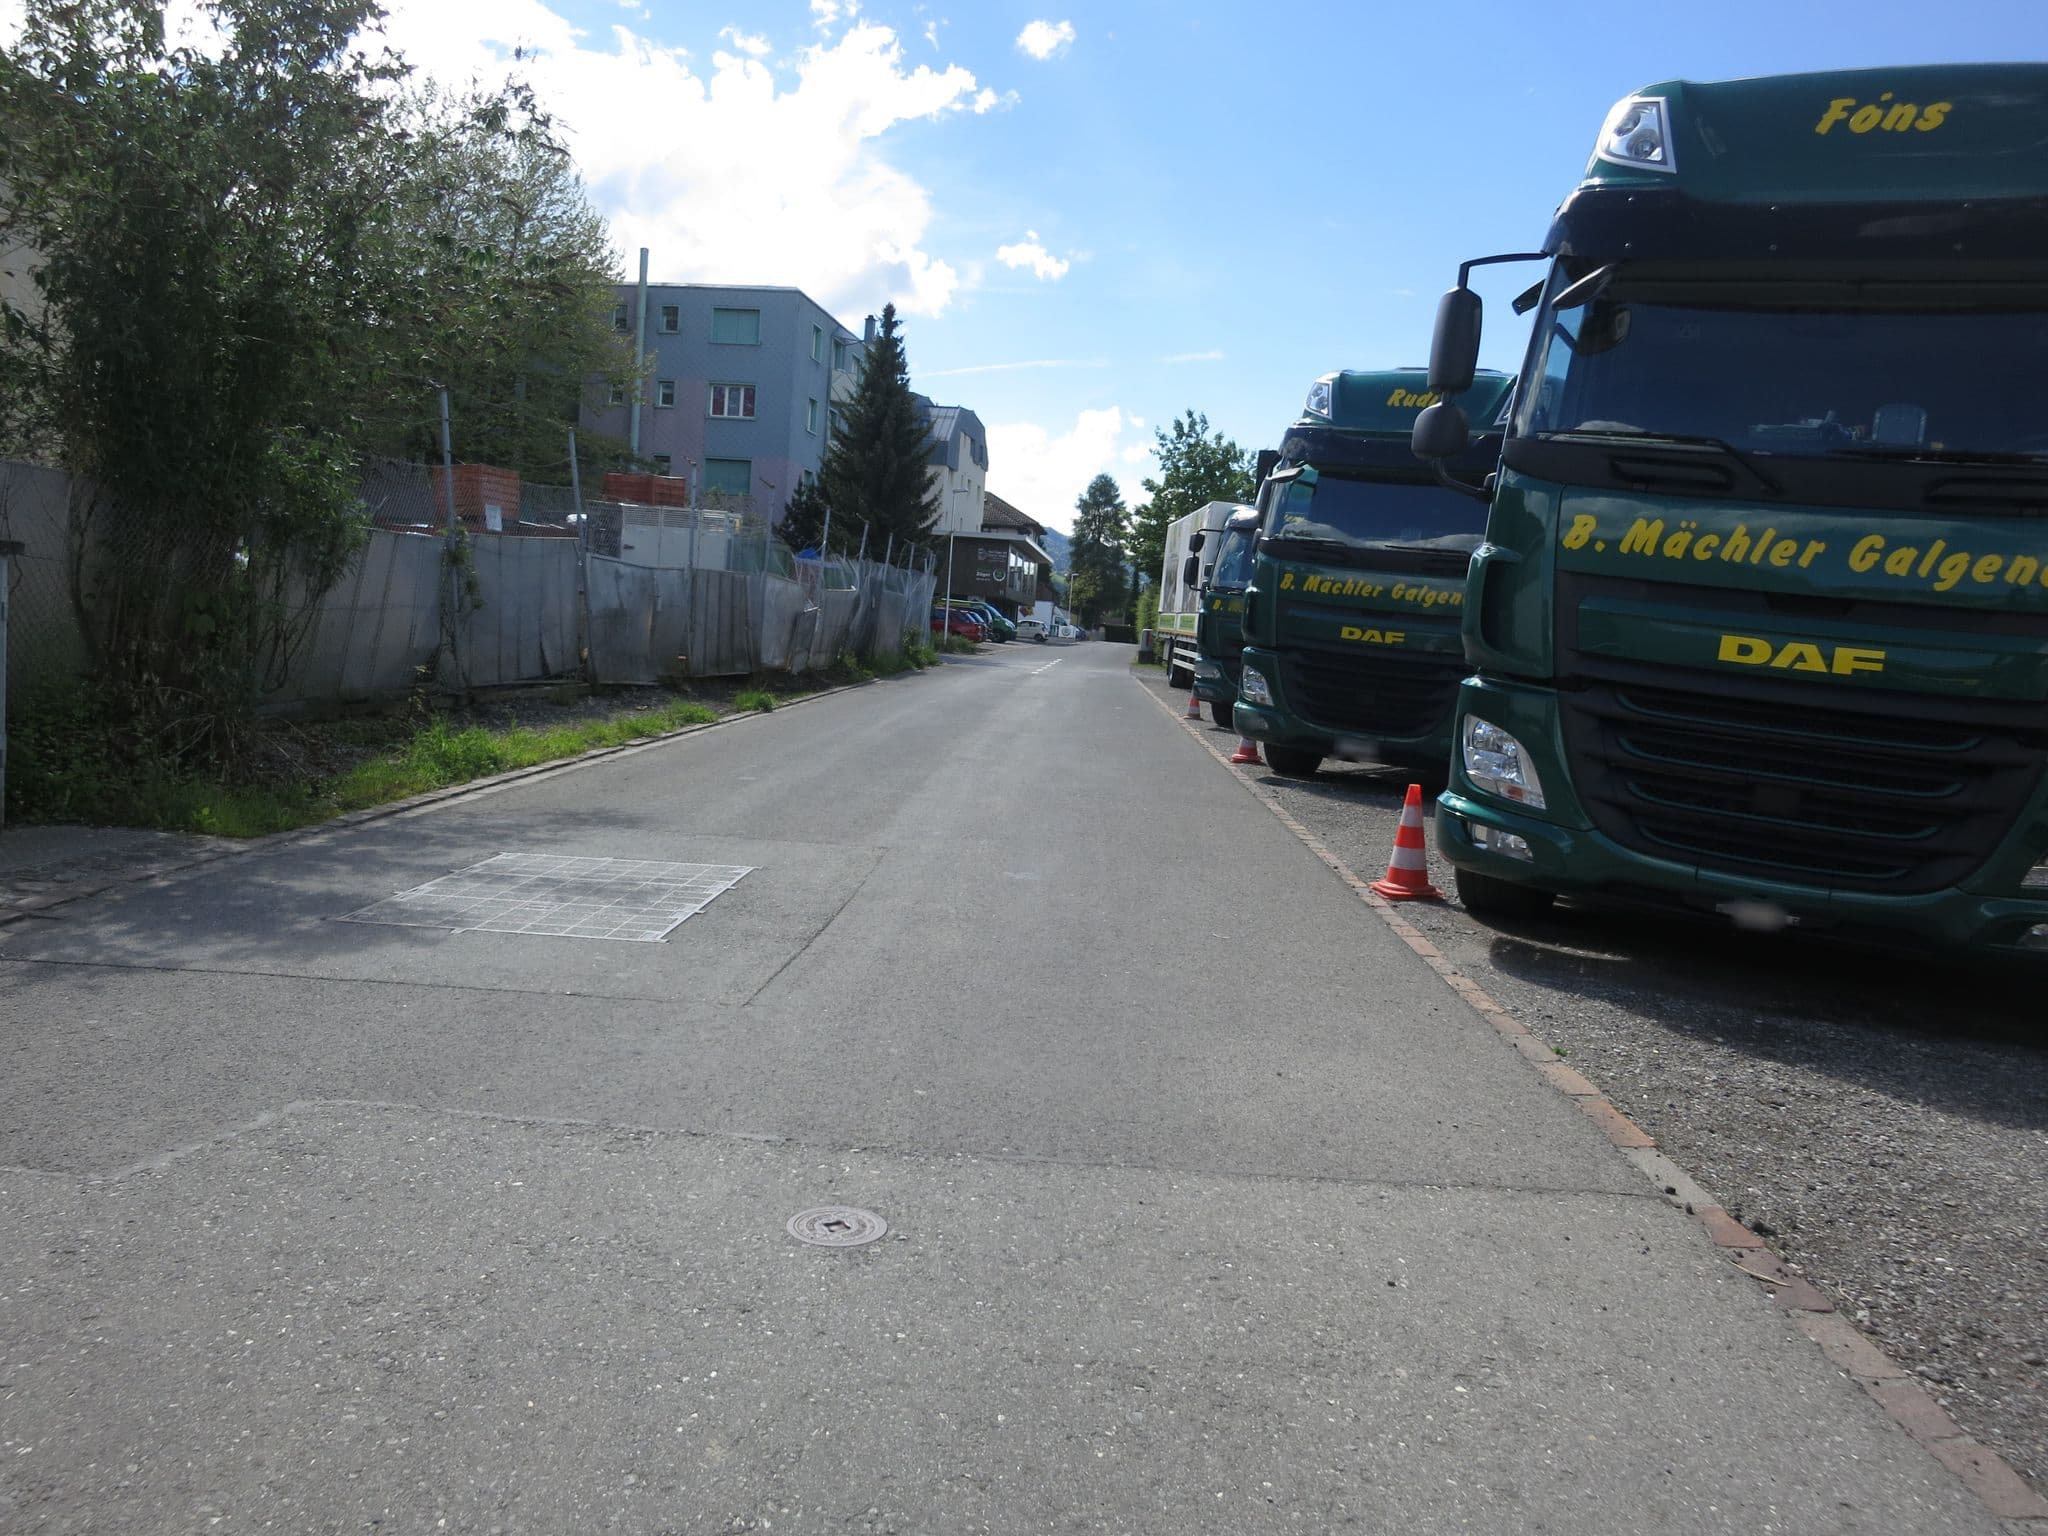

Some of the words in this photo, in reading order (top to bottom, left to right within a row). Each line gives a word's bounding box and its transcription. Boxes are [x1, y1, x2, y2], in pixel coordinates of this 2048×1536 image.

[1564, 514, 1605, 552] B.
[1619, 518, 1827, 568] Mächler
[1849, 534, 2048, 591] Galgen
[1280, 573, 1297, 591] B.
[1304, 576, 1383, 598] Mächler
[1391, 583, 1465, 608] Galgen
[1341, 627, 1406, 645] DAF
[1718, 634, 1886, 675] DAF
